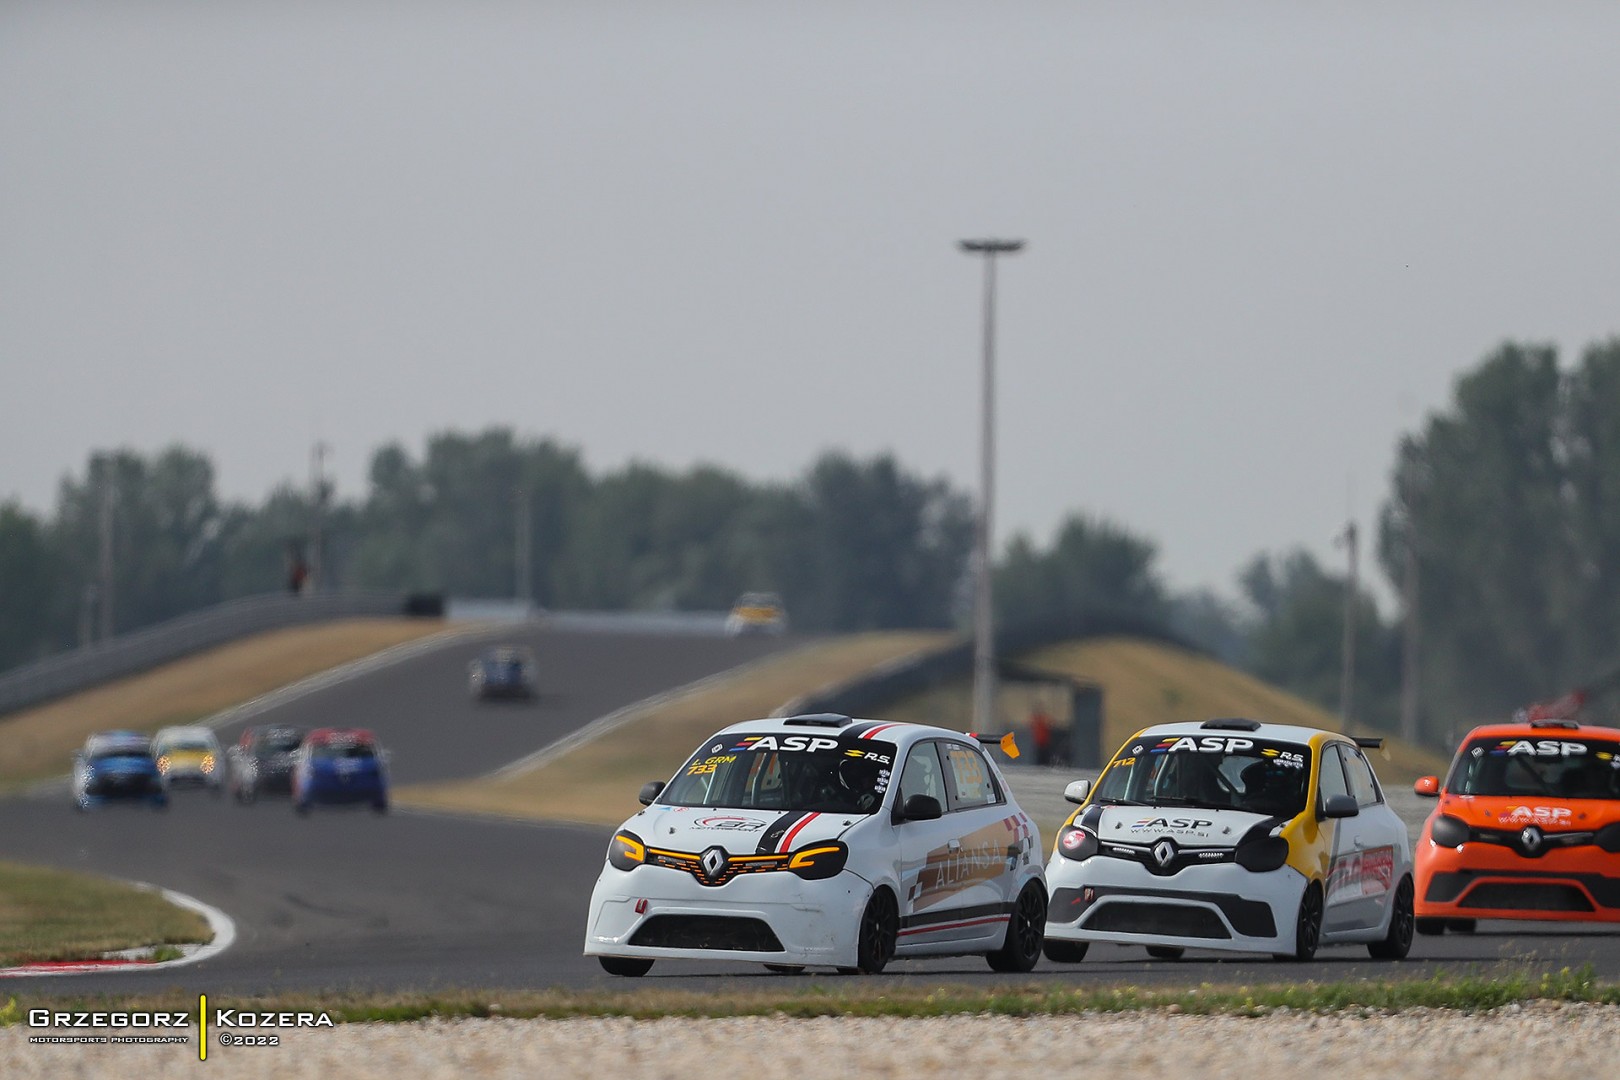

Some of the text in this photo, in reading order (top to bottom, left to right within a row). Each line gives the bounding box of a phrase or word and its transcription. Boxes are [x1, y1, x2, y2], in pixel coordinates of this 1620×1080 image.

[747, 736, 838, 752] ASP
[1168, 737, 1254, 753] ASP
[1507, 740, 1588, 756] ASP
[1113, 757, 1136, 768] 712
[686, 764, 718, 775] 733
[1511, 805, 1573, 818] ASP
[1145, 817, 1213, 829] ASP
